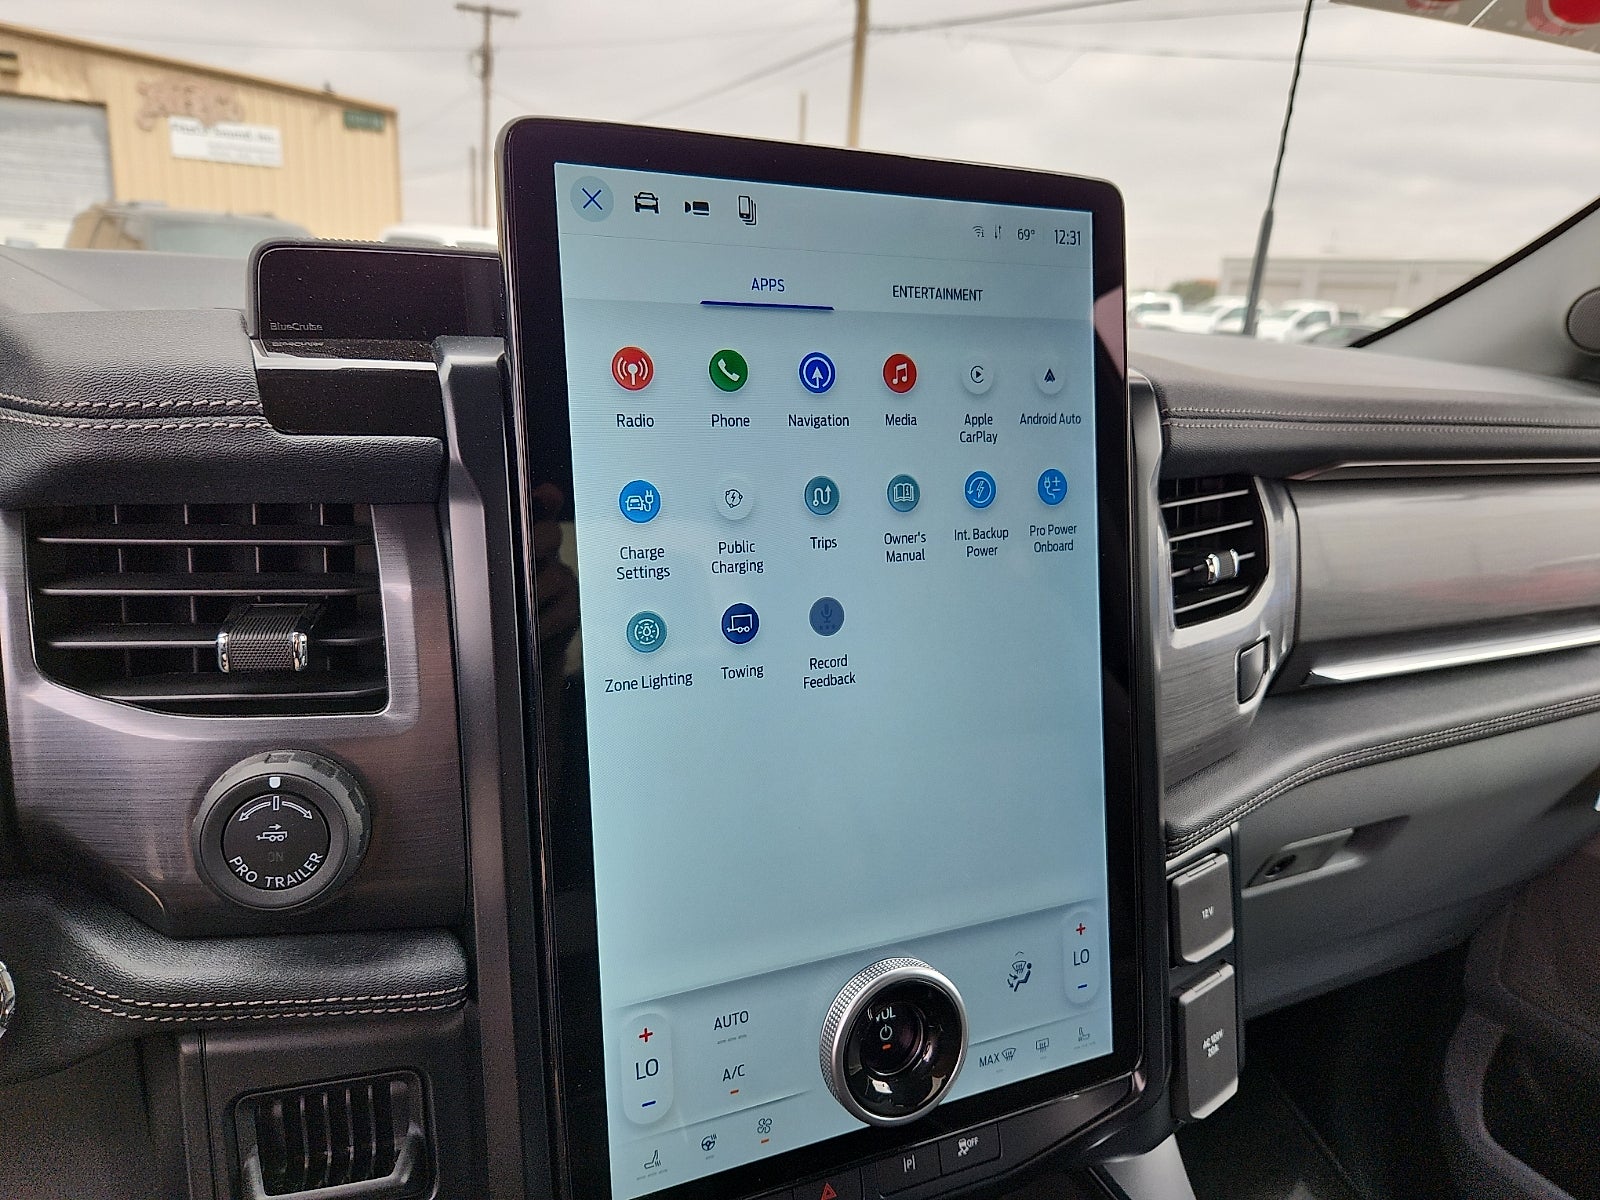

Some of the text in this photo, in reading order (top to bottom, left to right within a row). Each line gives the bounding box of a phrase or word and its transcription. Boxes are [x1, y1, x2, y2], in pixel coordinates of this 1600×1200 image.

[1054, 229, 1081, 246] 12:31
[751, 277, 785, 293] APPS
[892, 284, 984, 302] ENTERTAINMENT
[270, 322, 323, 331] BlueCruise
[616, 413, 655, 428] Radio
[711, 413, 751, 428] Phone
[788, 413, 850, 430] Navigation
[885, 412, 918, 427] Media
[964, 412, 994, 428] Apple
[1019, 412, 1082, 425] Android Auto
[959, 430, 998, 445] CarPlay
[883, 531, 927, 545] Owner's
[954, 526, 1009, 541] Int. Backup
[1029, 523, 1078, 537] Pro Power
[718, 539, 756, 555] Public
[809, 536, 838, 552] Trips
[966, 545, 998, 558] Power
[1033, 538, 1074, 553] Onboard
[619, 545, 665, 562] Charge
[886, 547, 926, 563] Manual
[616, 564, 671, 581] Settings
[711, 560, 764, 575] Charging
[809, 653, 848, 671] Record
[720, 664, 764, 680] Towing
[604, 672, 693, 693] Zone Lighting
[803, 671, 857, 690] Feedback
[229, 852, 323, 888] PRO TRAILER
[1201, 906, 1214, 919] 12V
[1073, 948, 1090, 967] LO
[713, 1010, 749, 1031] AUTO
[979, 1052, 1000, 1068] MAX
[635, 1058, 659, 1081] LO
[722, 1063, 746, 1082] A/C
[967, 1136, 978, 1147] OFF
